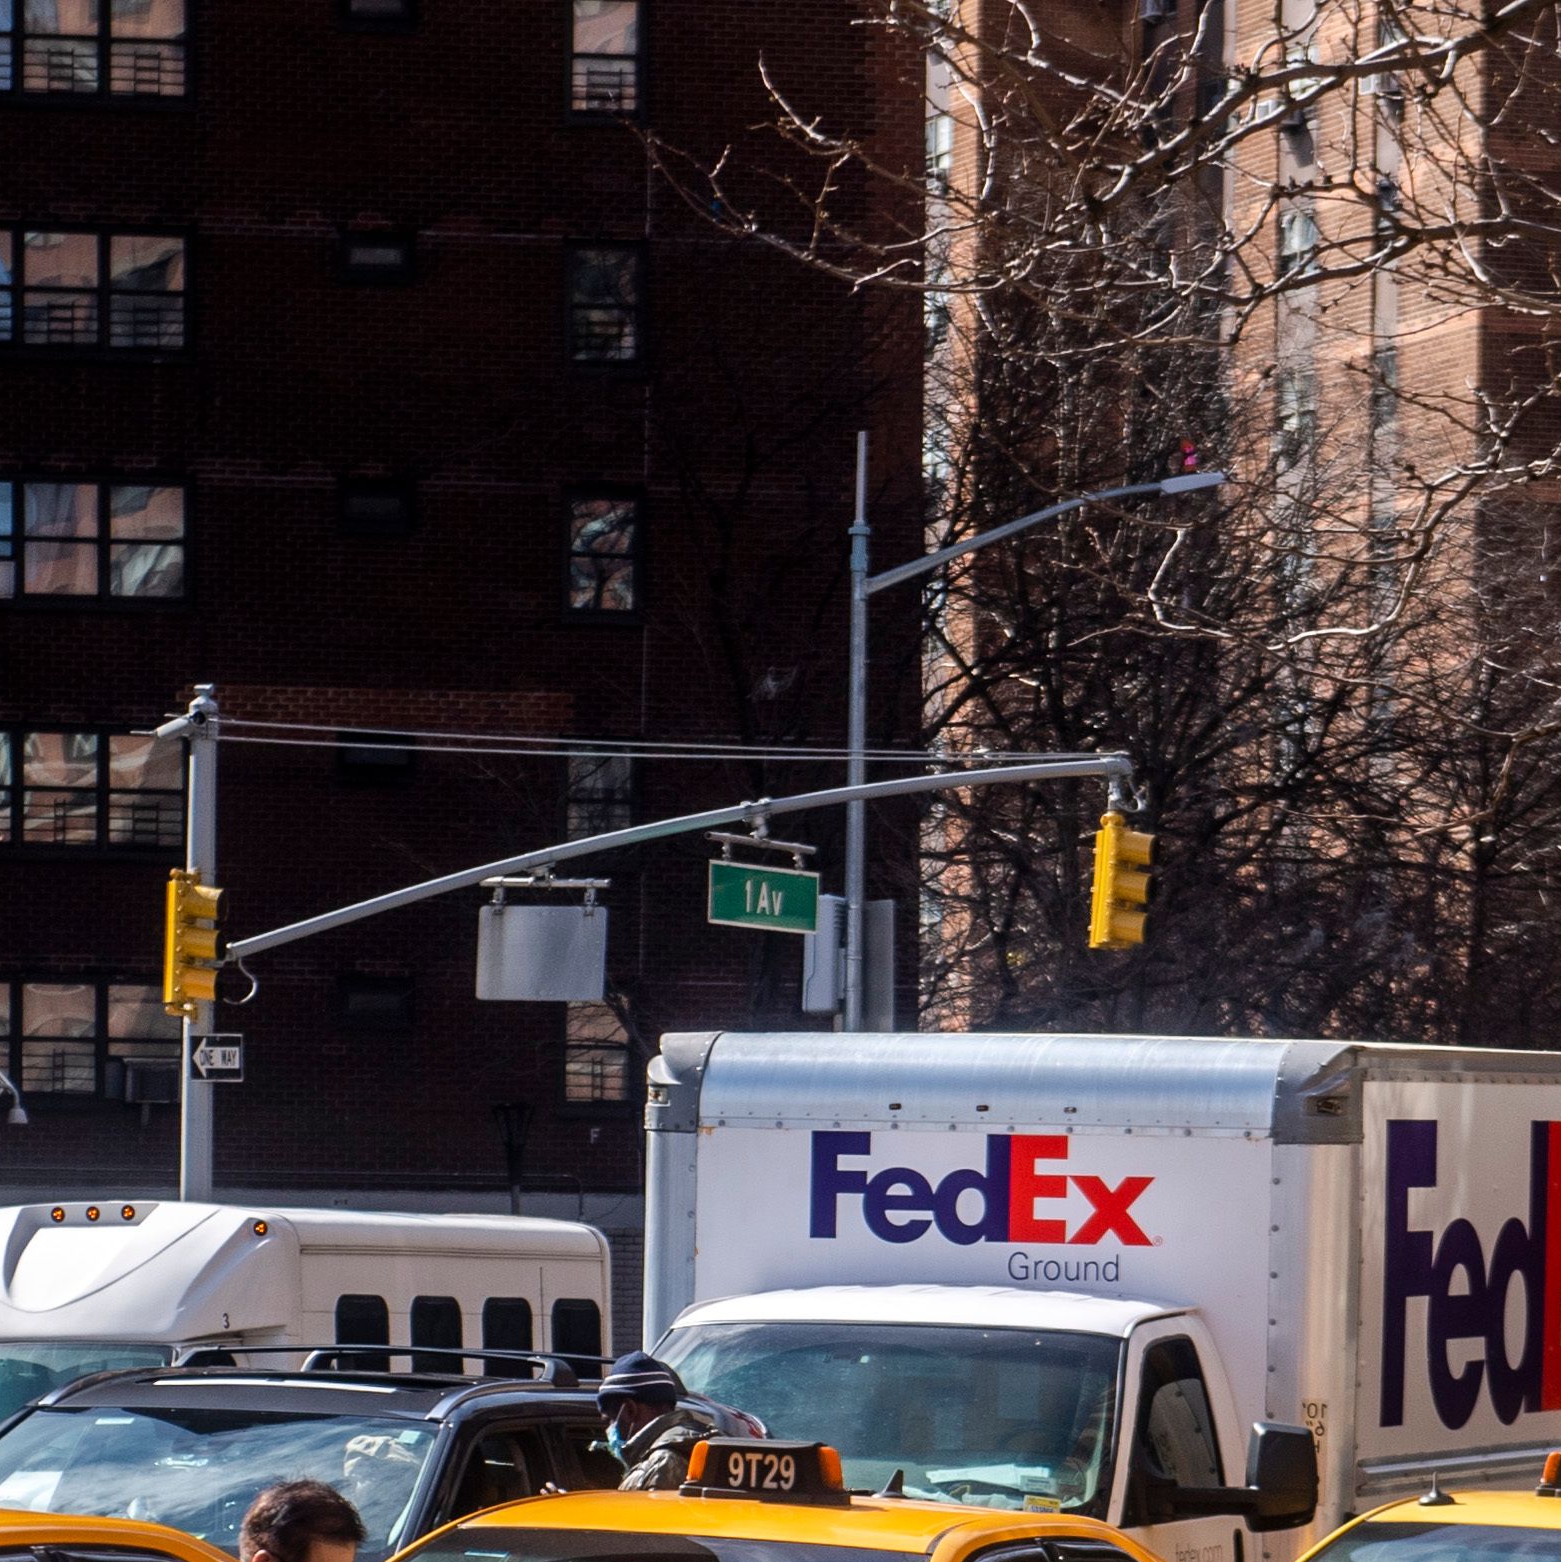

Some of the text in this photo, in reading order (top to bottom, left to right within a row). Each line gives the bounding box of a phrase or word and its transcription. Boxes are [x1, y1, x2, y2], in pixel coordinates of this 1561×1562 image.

[745, 880, 783, 916] 1 Av
[200, 1048, 237, 1067] ONE WAY
[809, 1130, 1156, 1246] FedEx
[1007, 1251, 1120, 1282] Ground
[222, 1312, 230, 1329] 3
[728, 1452, 795, 1490] 9T29
